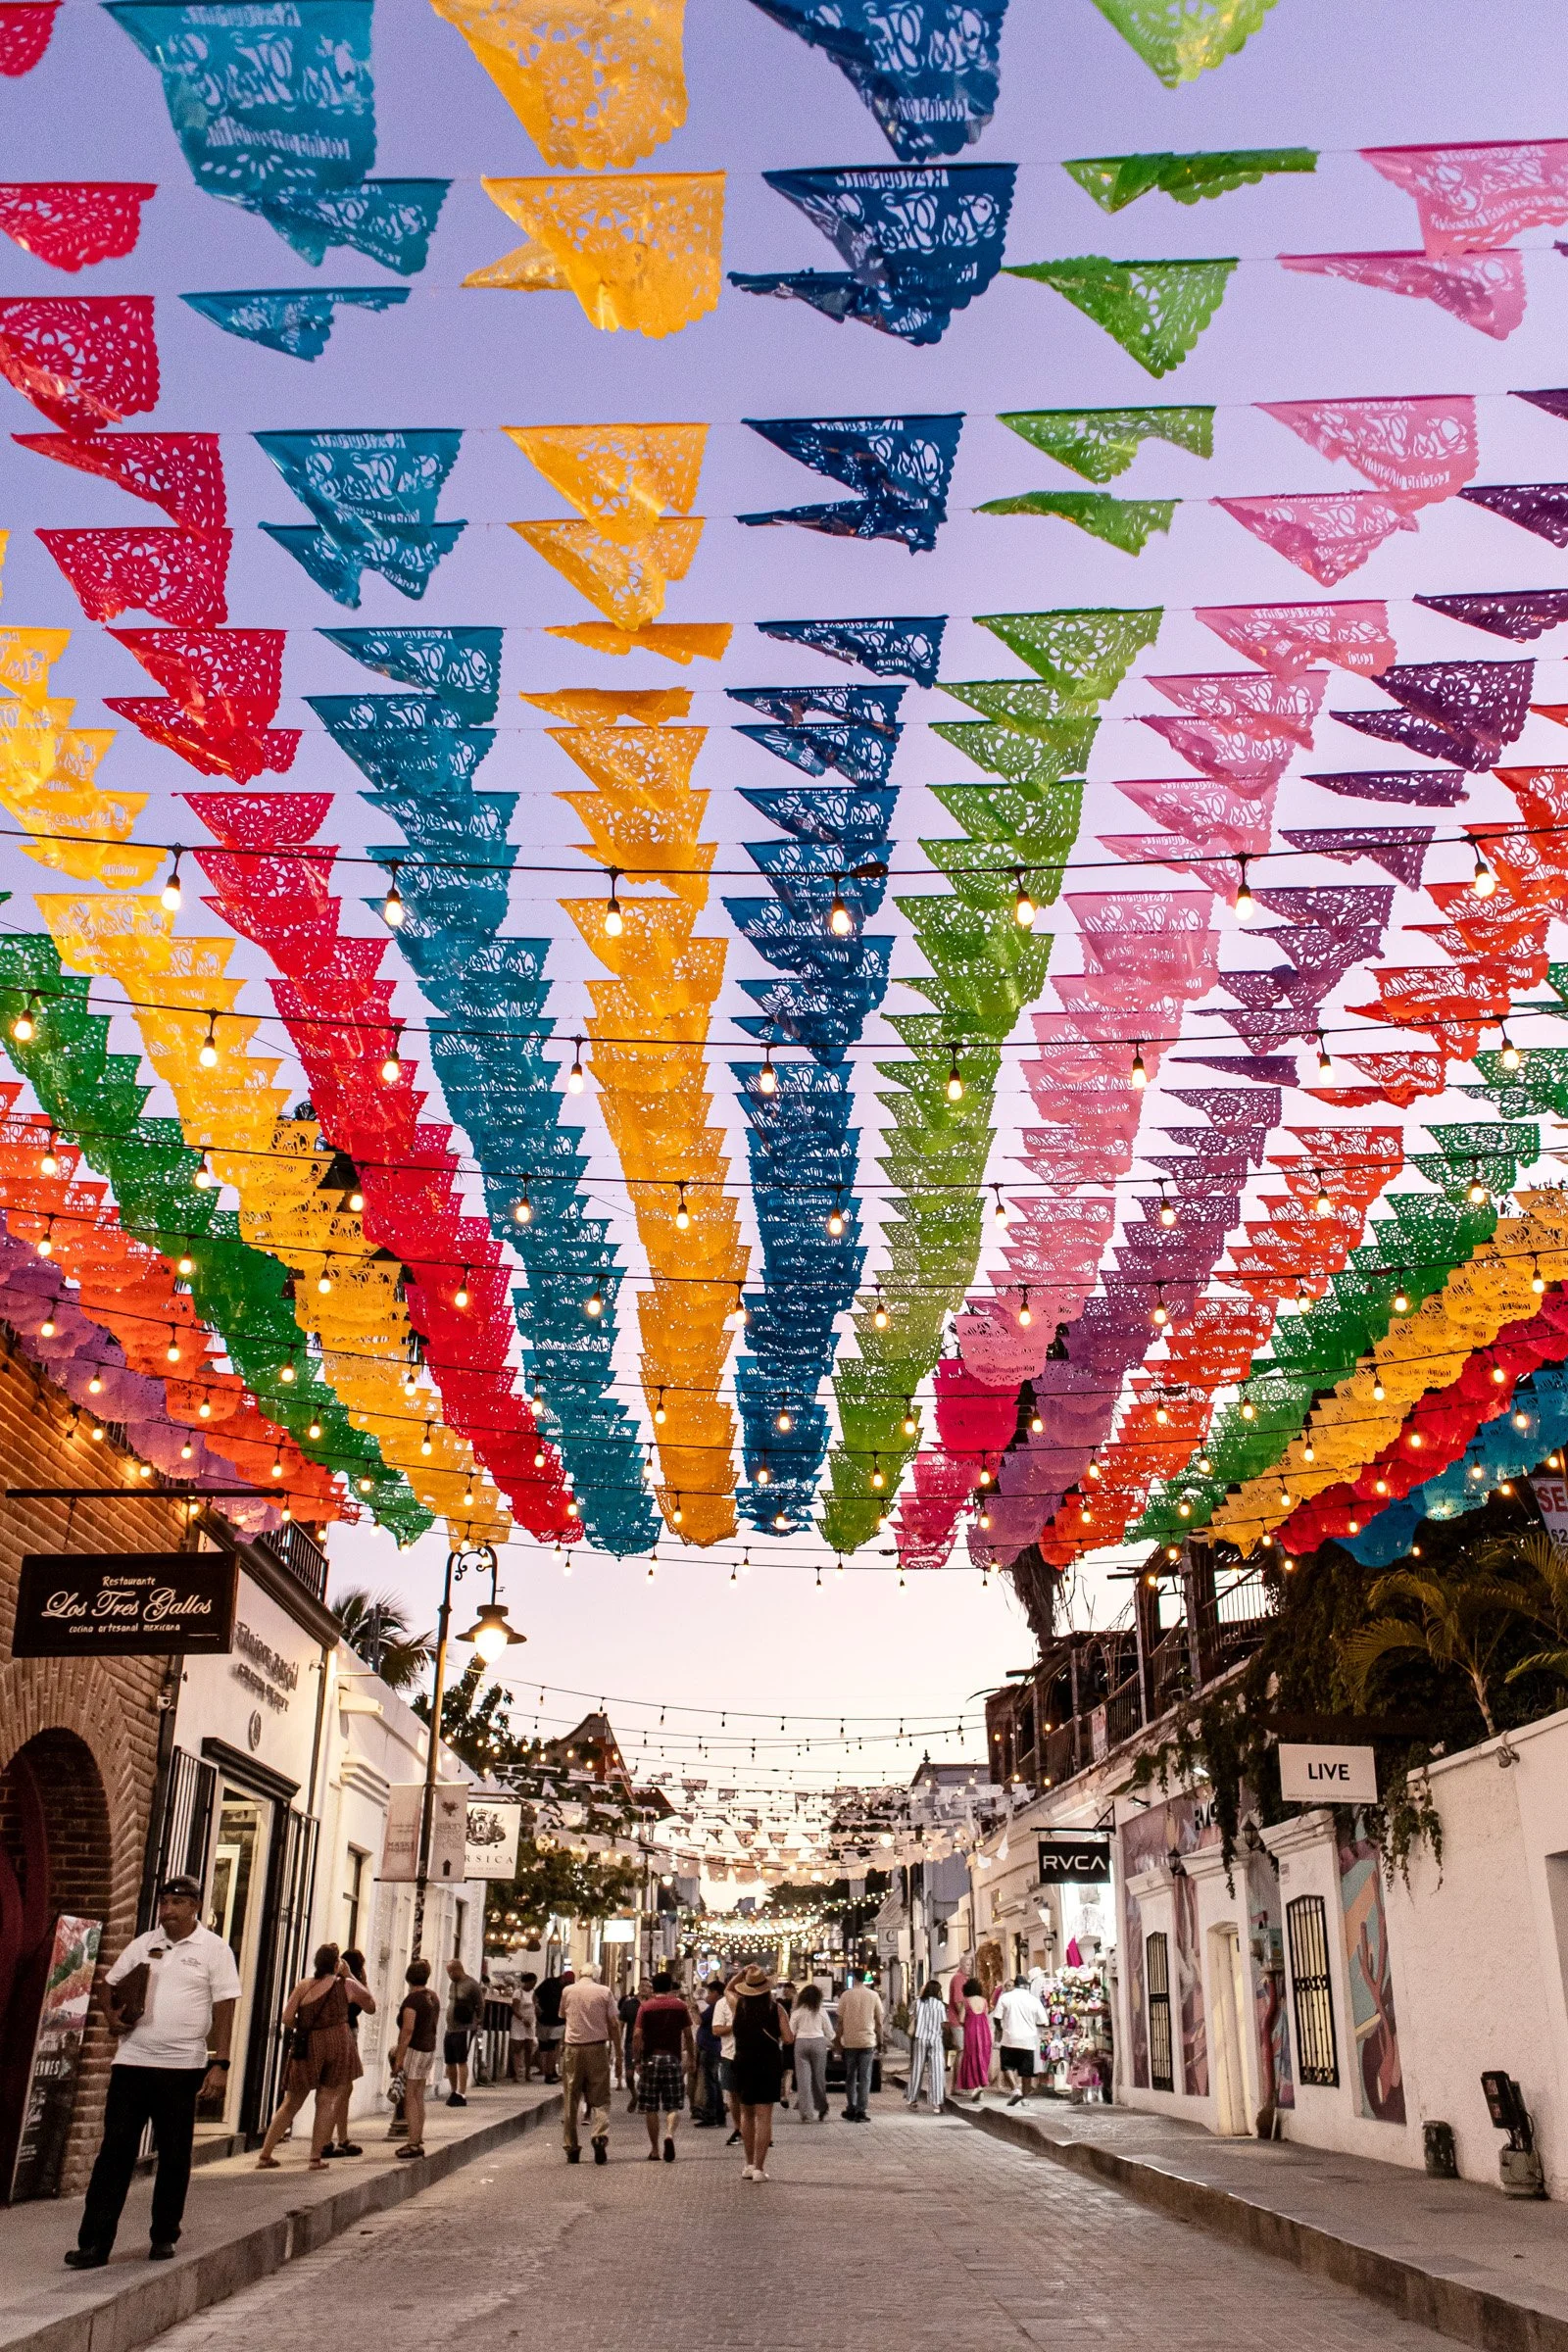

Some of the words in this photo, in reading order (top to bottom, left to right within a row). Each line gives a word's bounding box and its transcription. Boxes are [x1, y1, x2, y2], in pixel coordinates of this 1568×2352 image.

[102, 1576, 156, 1587] Restaurante
[41, 1591, 86, 1618] Los
[91, 1590, 138, 1617] Tres
[143, 1587, 213, 1622] Gallos
[69, 1625, 94, 1634] cocina
[98, 1623, 139, 1633] artesanal
[143, 1623, 181, 1632] mexicana
[1308, 1763, 1350, 1781] LIVE
[1194, 1801, 1217, 1831] RVC
[465, 1855, 514, 1864] RSICA
[1043, 1855, 1106, 1870] RVCA
